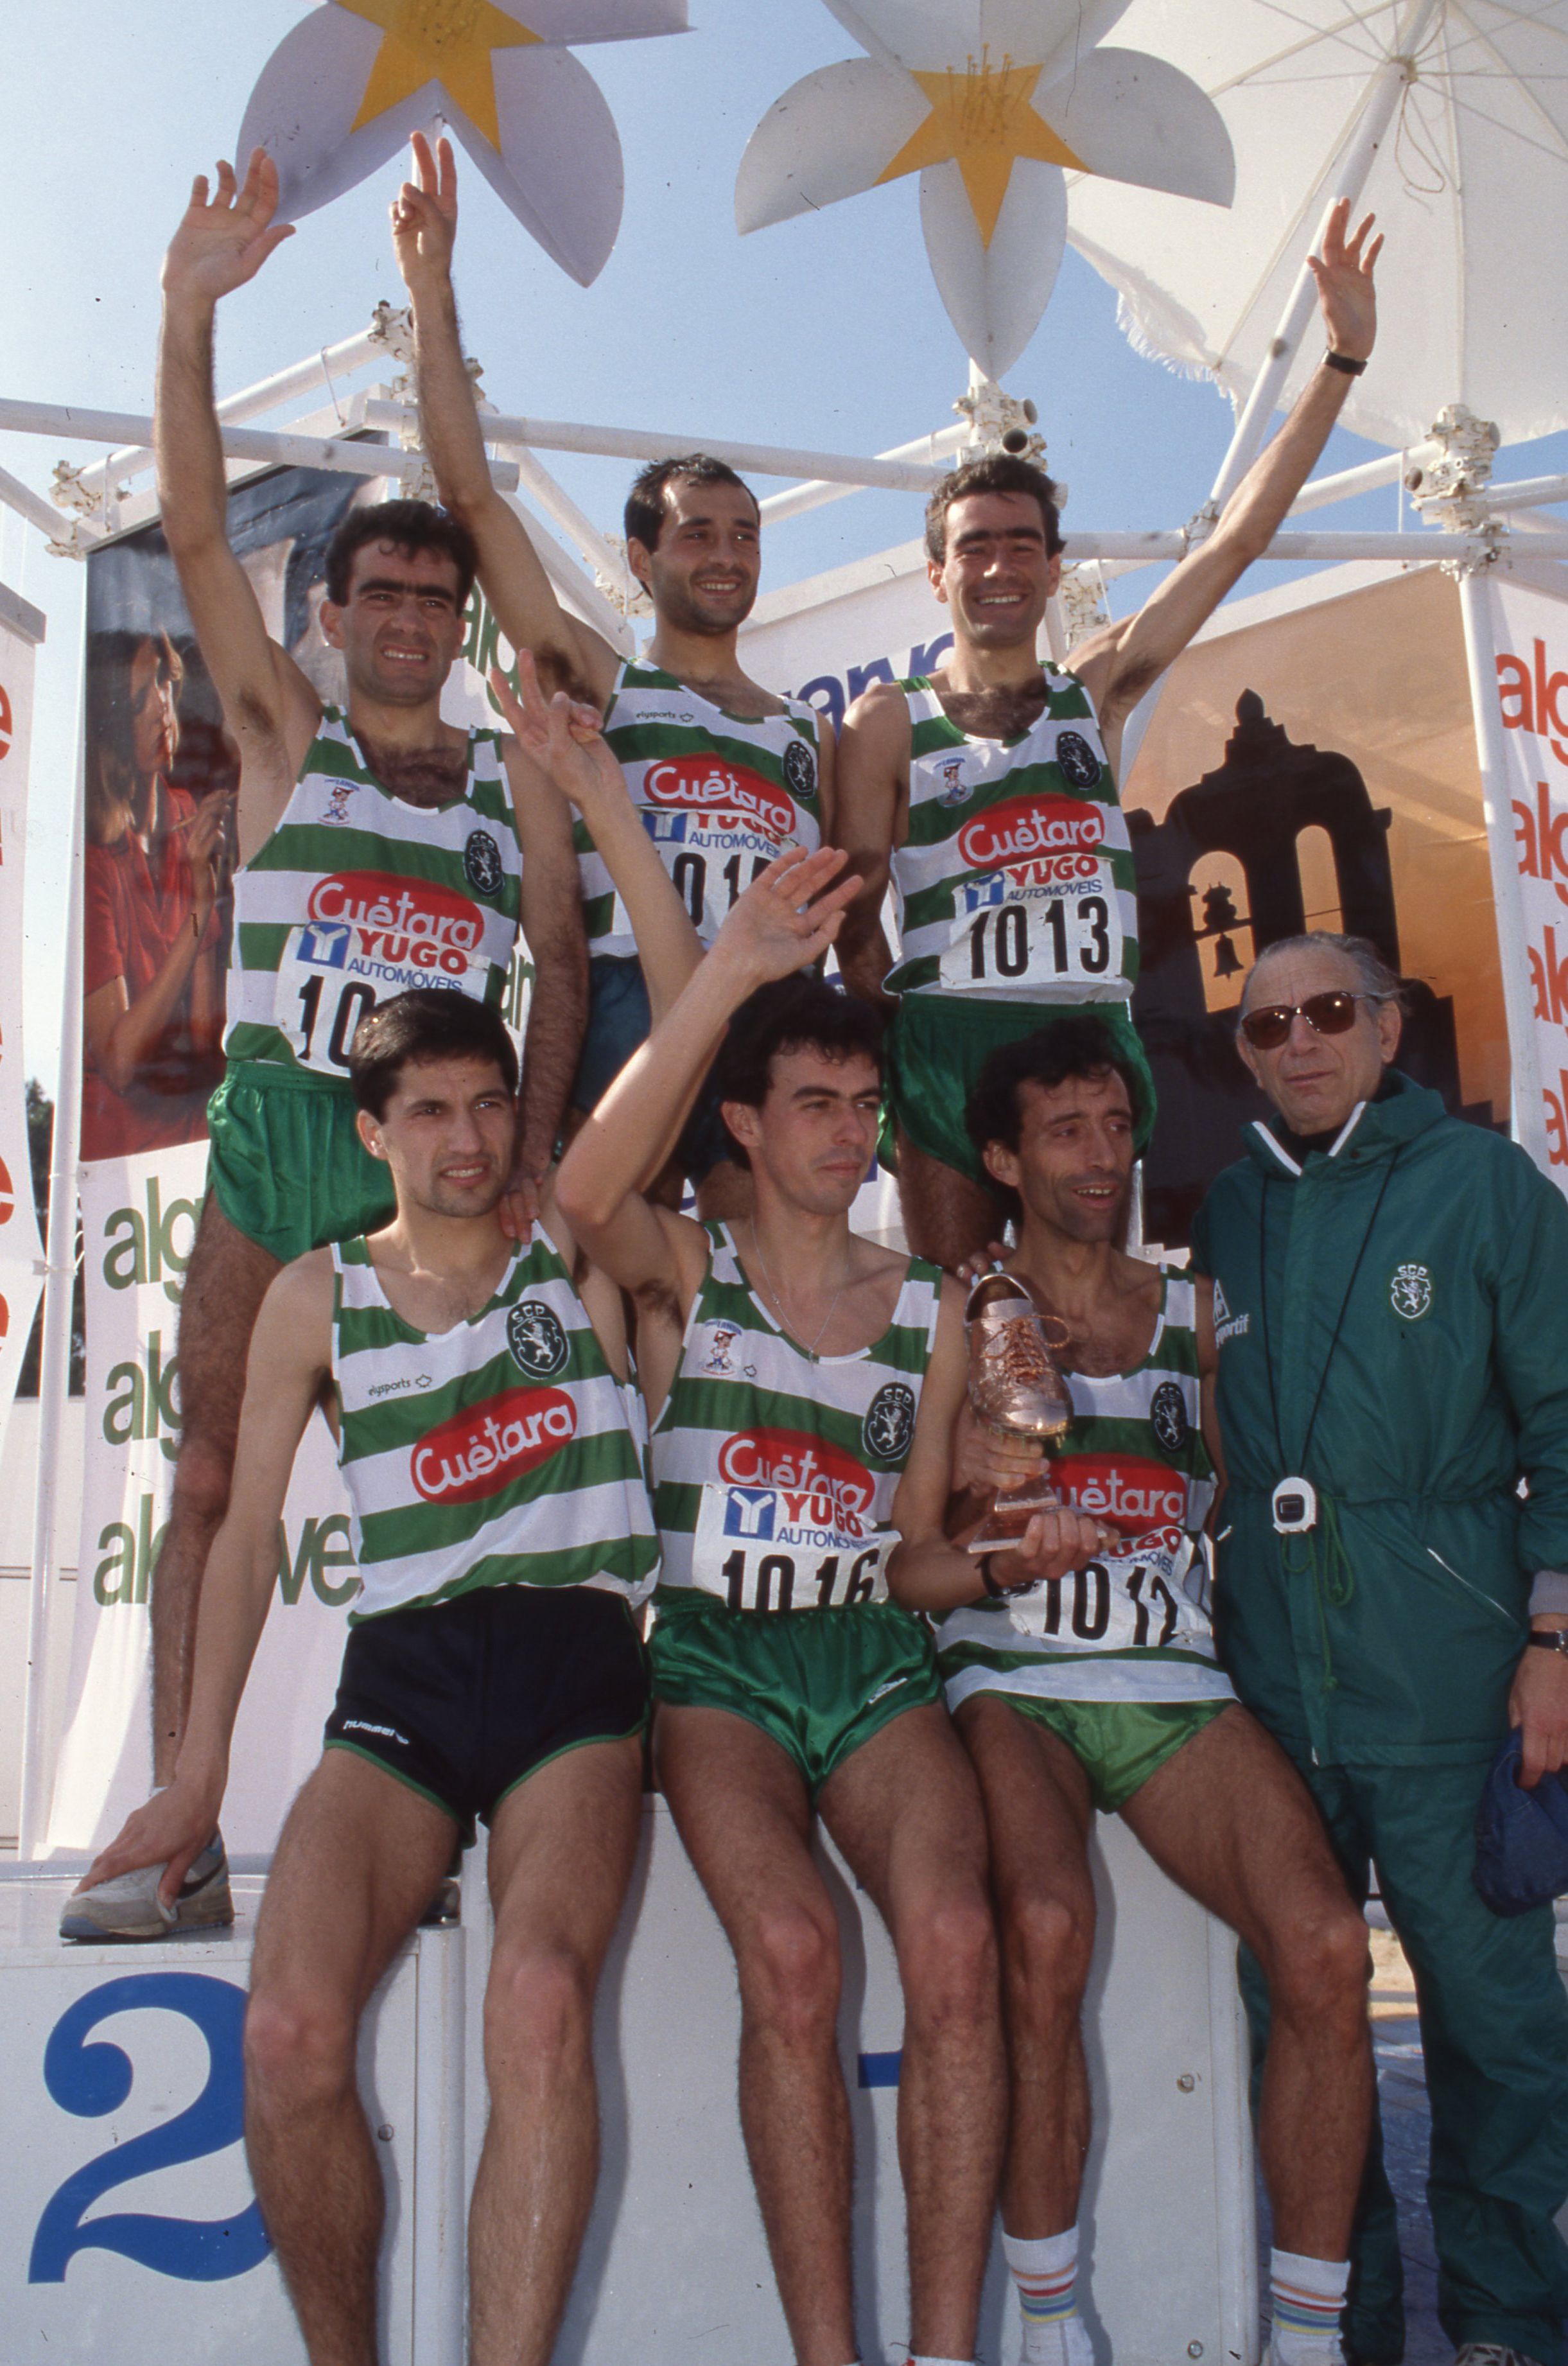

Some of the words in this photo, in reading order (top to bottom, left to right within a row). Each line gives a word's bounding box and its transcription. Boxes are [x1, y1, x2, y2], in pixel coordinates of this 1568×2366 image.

[649, 766, 792, 834] Cuétara
[964, 809, 1103, 862] Cuétara
[658, 850, 772, 927] 01
[1007, 855, 1099, 887] YUGO
[1007, 879, 1102, 901] AUTOMÓVEIS
[313, 882, 476, 949] Cuétara
[970, 897, 1110, 979] 1013
[357, 929, 468, 976] YUGO
[1397, 1264, 1427, 1277] SCP
[511, 1304, 546, 1322] SCP
[884, 1388, 912, 1403] SCP
[415, 1404, 574, 1494] Cuétara
[724, 1439, 868, 1514] Cuétara
[1056, 1469, 1184, 1519] uétara
[781, 1491, 863, 1538] YUGO
[1108, 1527, 1183, 1558] UGO
[722, 1548, 880, 1610] 1016
[28, 1971, 275, 2284] 2
